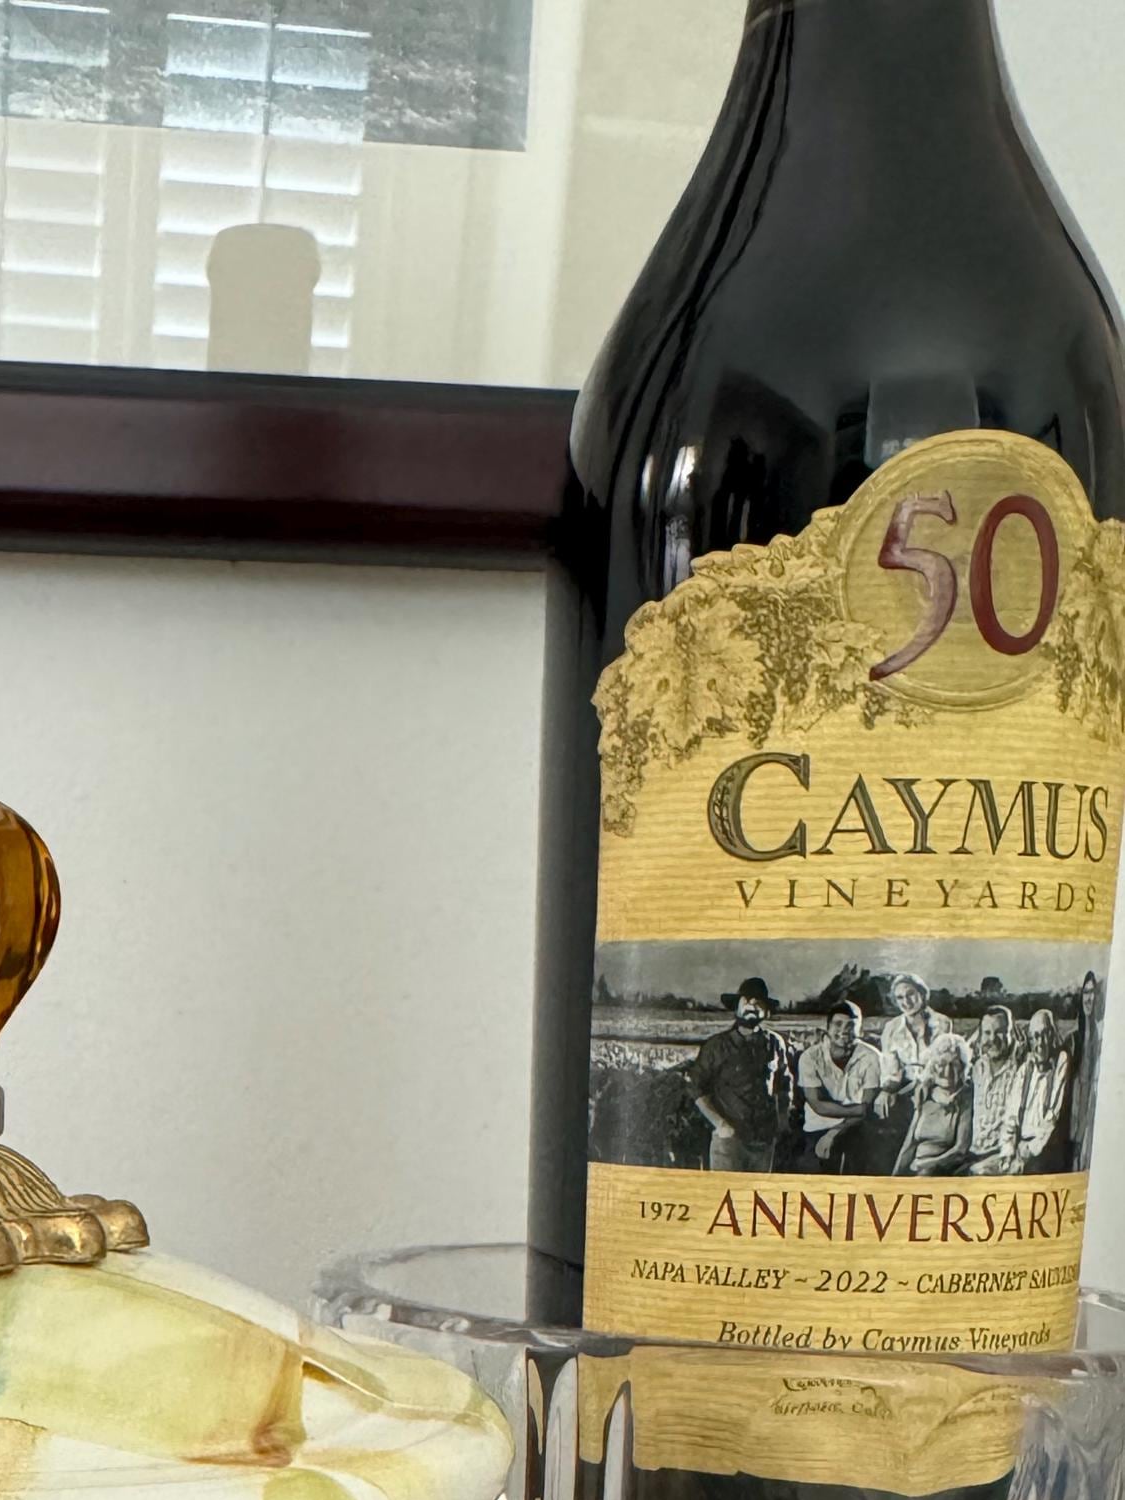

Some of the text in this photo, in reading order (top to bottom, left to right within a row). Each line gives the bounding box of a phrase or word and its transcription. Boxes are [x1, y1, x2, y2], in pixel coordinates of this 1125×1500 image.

[869, 490, 1060, 681] 50
[707, 752, 1109, 862] CAYMUS
[736, 878, 1097, 912] VINEYARDS
[638, 1201, 691, 1222] 1972
[706, 1188, 1070, 1243] ANNIVERSARY
[630, 1258, 687, 1284] NAPA
[694, 1264, 790, 1290] VALLEY
[813, 1269, 889, 1294] 2022
[916, 1270, 1028, 1295] CABERNET
[717, 1320, 1052, 1354] Bottled by Caymus Vineyards
